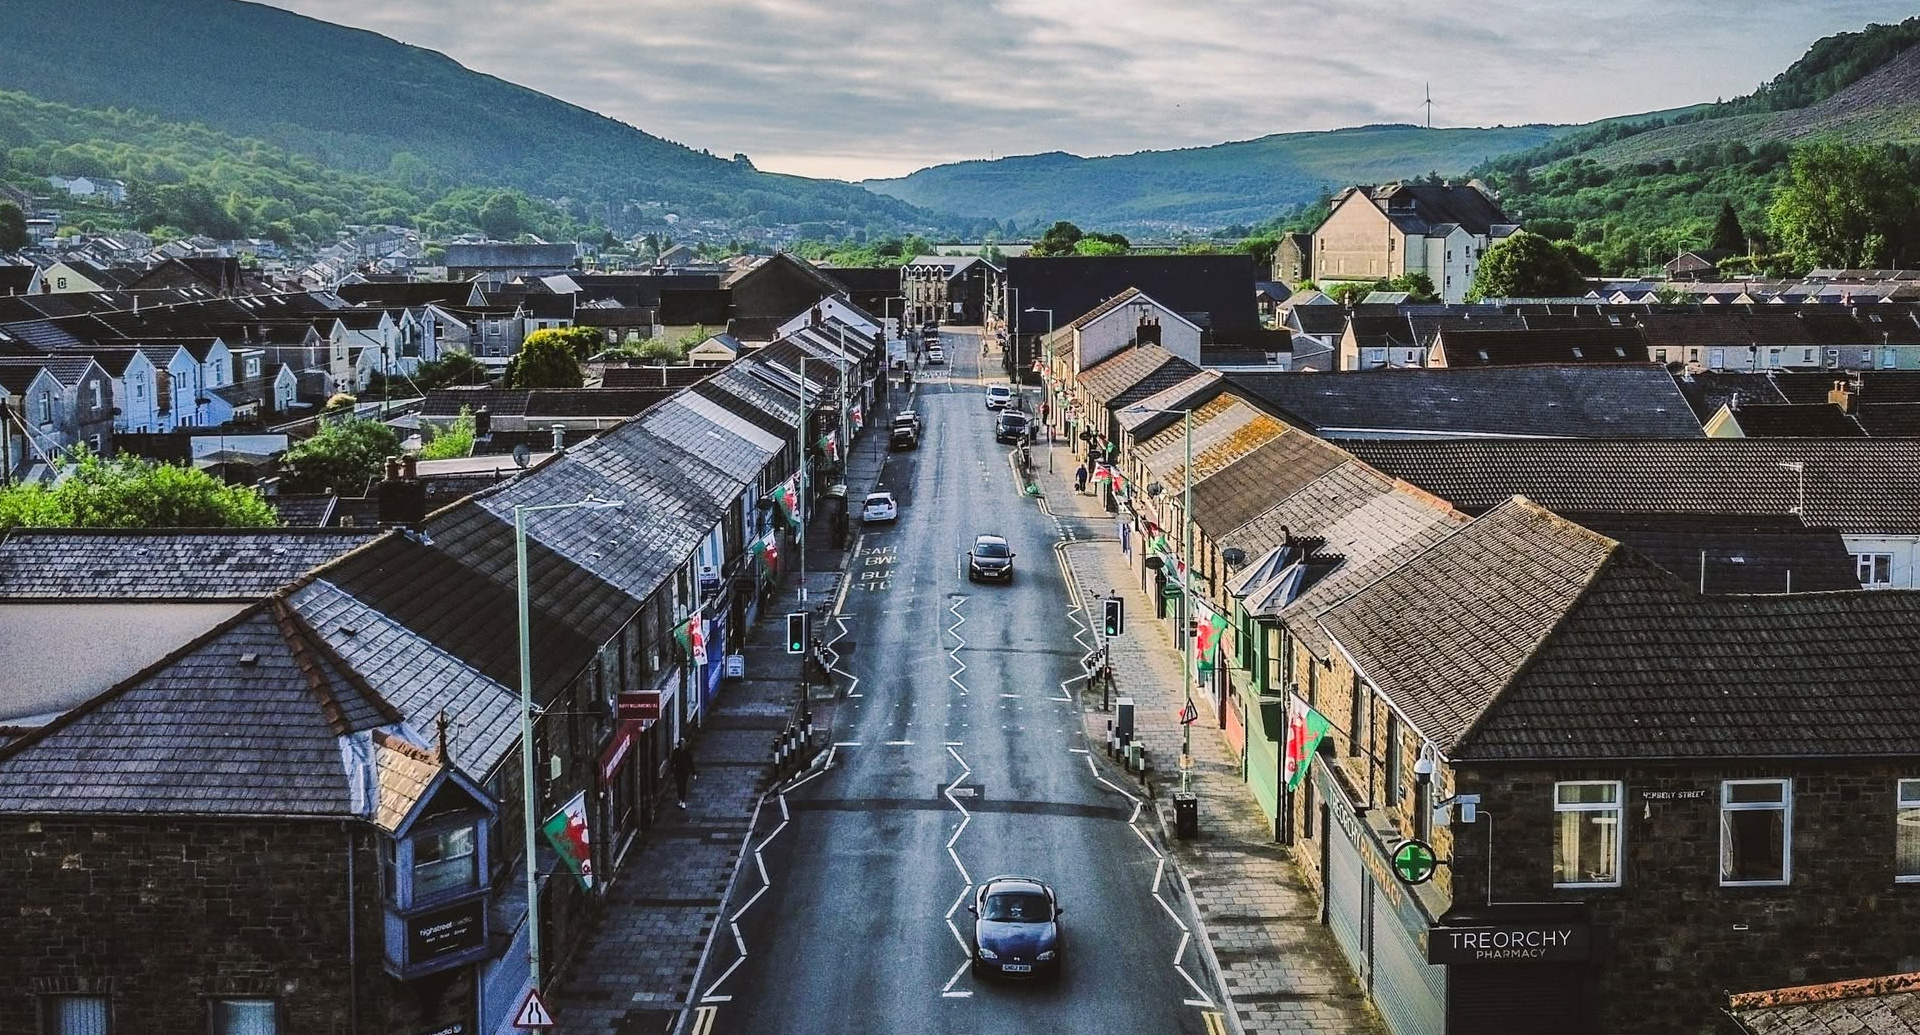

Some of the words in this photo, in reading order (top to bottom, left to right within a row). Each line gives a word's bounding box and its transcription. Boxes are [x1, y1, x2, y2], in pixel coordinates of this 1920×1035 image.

[1678, 790, 1705, 799] STREET
[1329, 787, 1361, 850] TREORCHY
[1450, 930, 1572, 949] TREORCHY
[1476, 948, 1546, 959] PHARMACY
